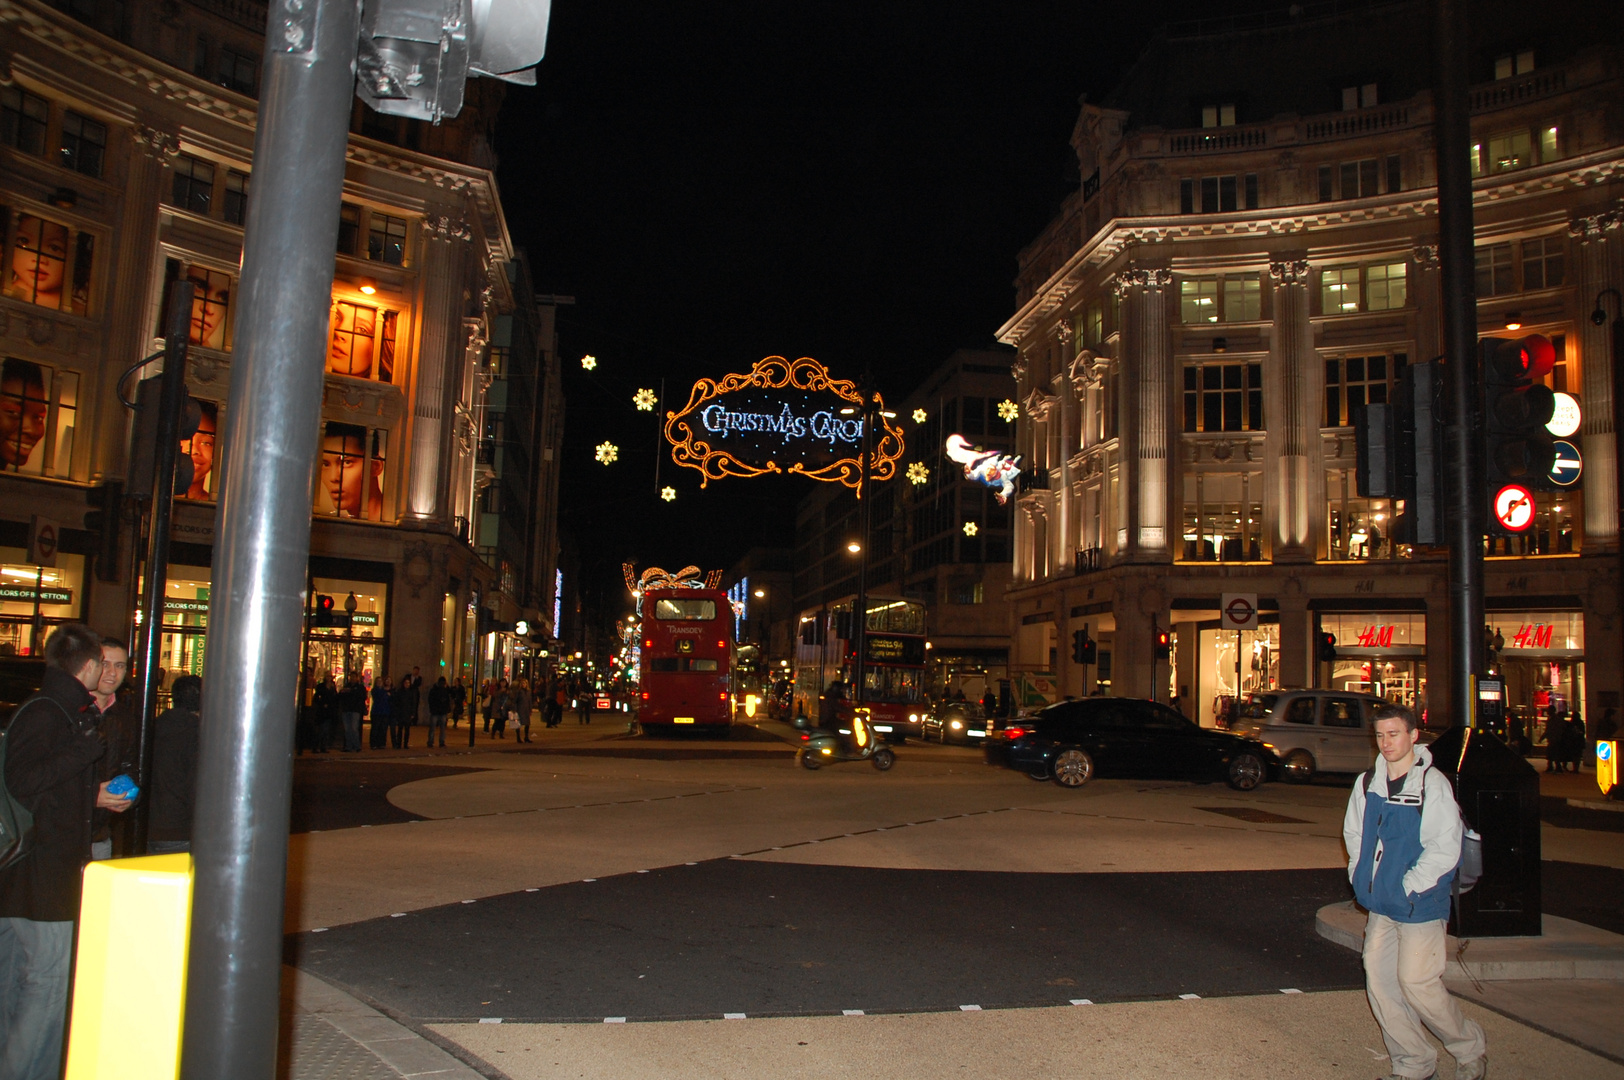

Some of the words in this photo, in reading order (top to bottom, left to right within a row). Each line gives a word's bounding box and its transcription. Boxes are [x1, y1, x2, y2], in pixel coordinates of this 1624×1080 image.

[701, 405, 806, 442] CHRISTMAS
[172, 523, 199, 533] OLORS
[0, 589, 18, 597] LORS
[19, 590, 29, 598] OF
[30, 591, 68, 600] BNETTON
[667, 625, 703, 634] TRANSDEV
[1357, 625, 1395, 648] H&M
[1513, 624, 1554, 649] H&M
[1479, 691, 1500, 700] WAIT
